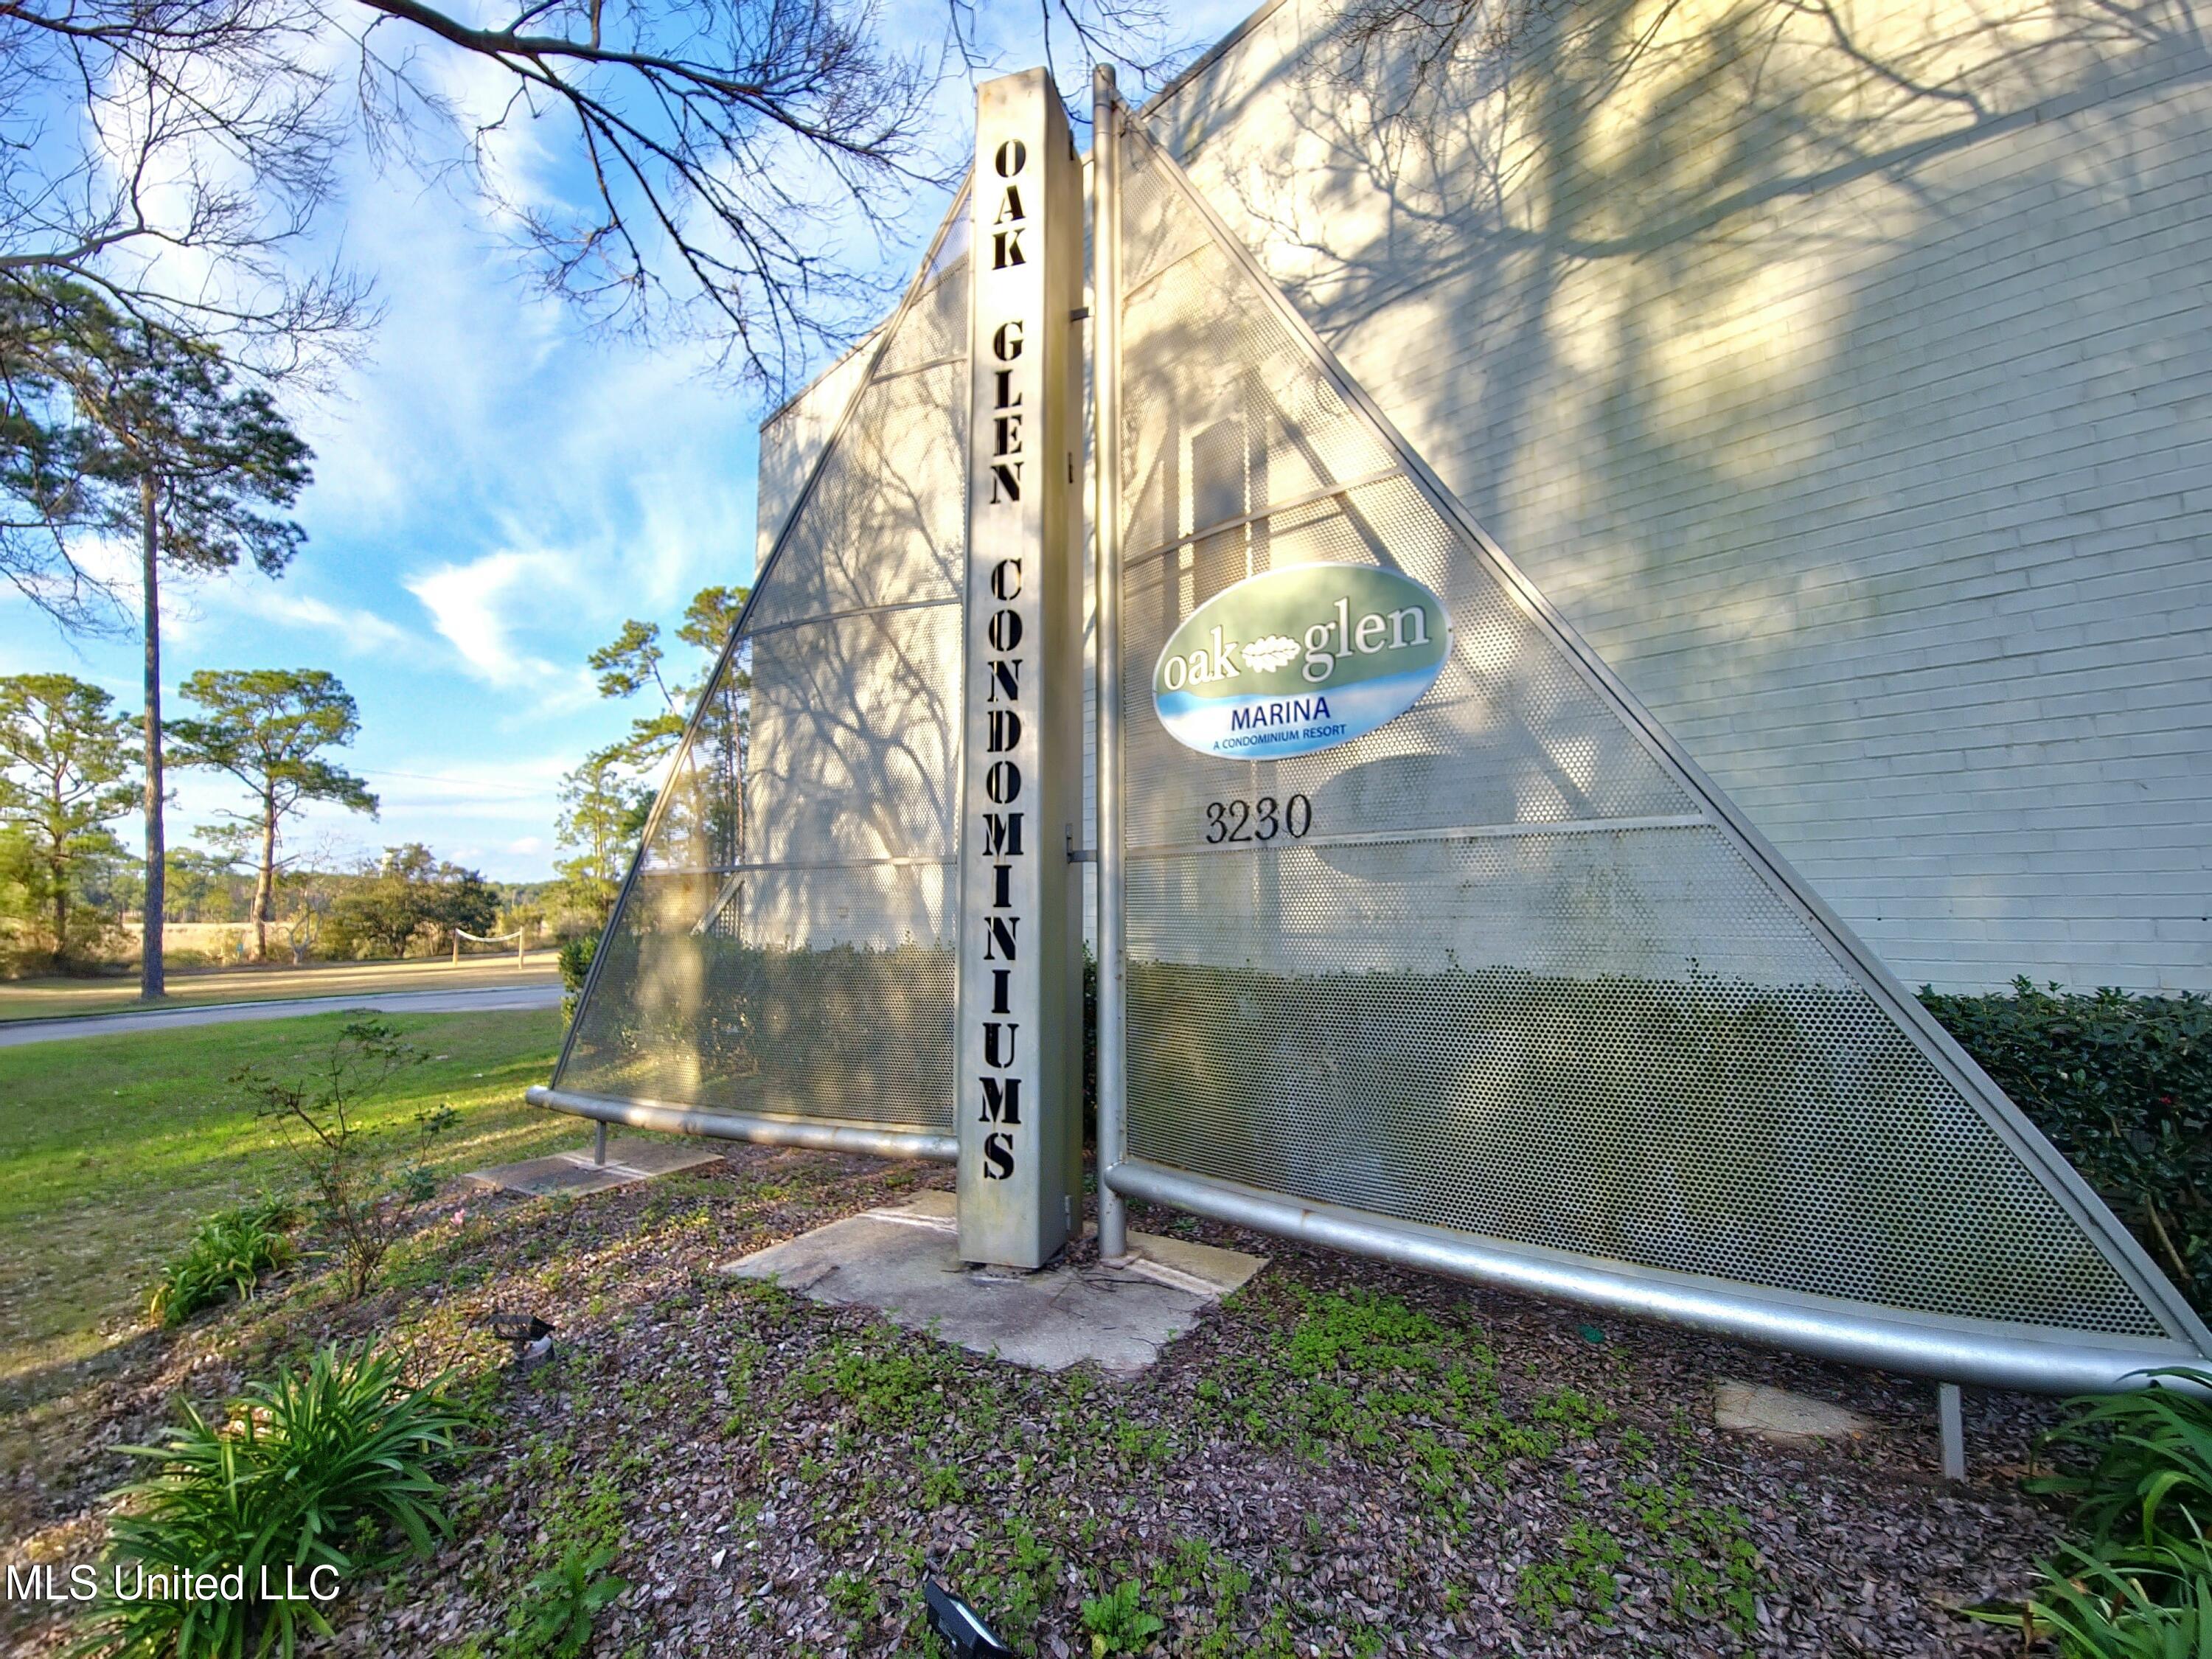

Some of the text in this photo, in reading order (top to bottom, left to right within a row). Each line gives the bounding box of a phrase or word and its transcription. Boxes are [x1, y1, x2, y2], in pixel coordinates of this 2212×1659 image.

[978, 139, 1026, 1181] OAK GLEN CONDOMINIUMS
[1164, 597, 1430, 690] oak glen
[1213, 724, 1347, 750] A CONDOMINIUM RESORT
[1231, 696, 1330, 731] MARINA
[1206, 794, 1312, 844] 3230
